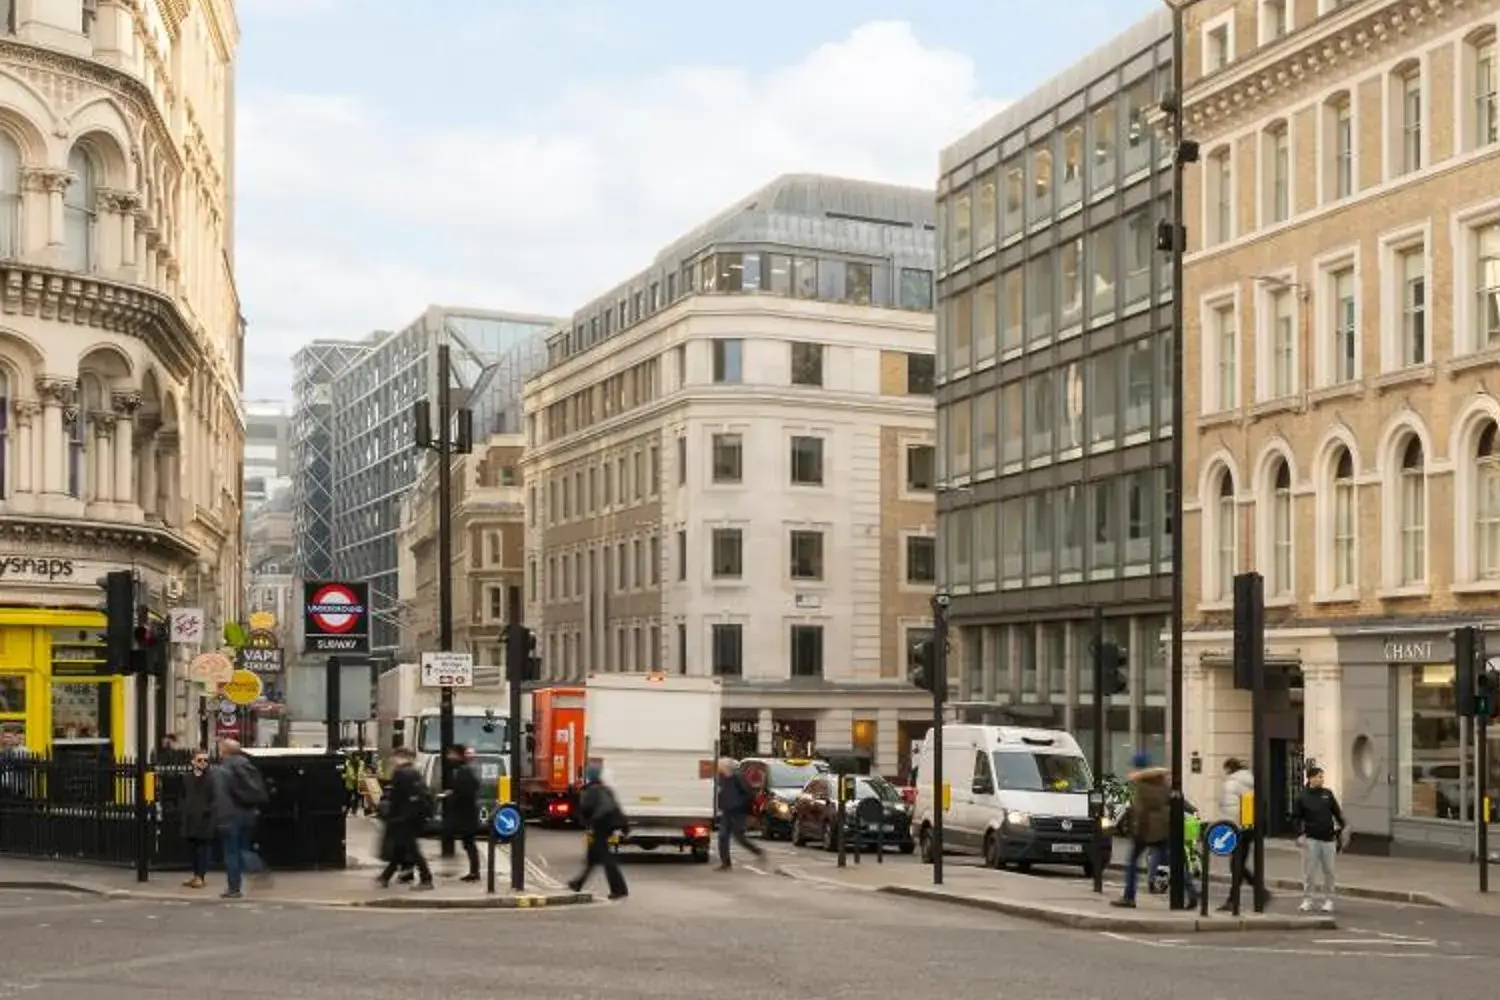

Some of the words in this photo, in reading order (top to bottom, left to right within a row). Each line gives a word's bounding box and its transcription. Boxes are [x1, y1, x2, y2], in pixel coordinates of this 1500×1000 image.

[317, 639, 357, 649] SUBWAY
[243, 649, 281, 661] VAPE
[1383, 641, 1432, 660] CHANT
